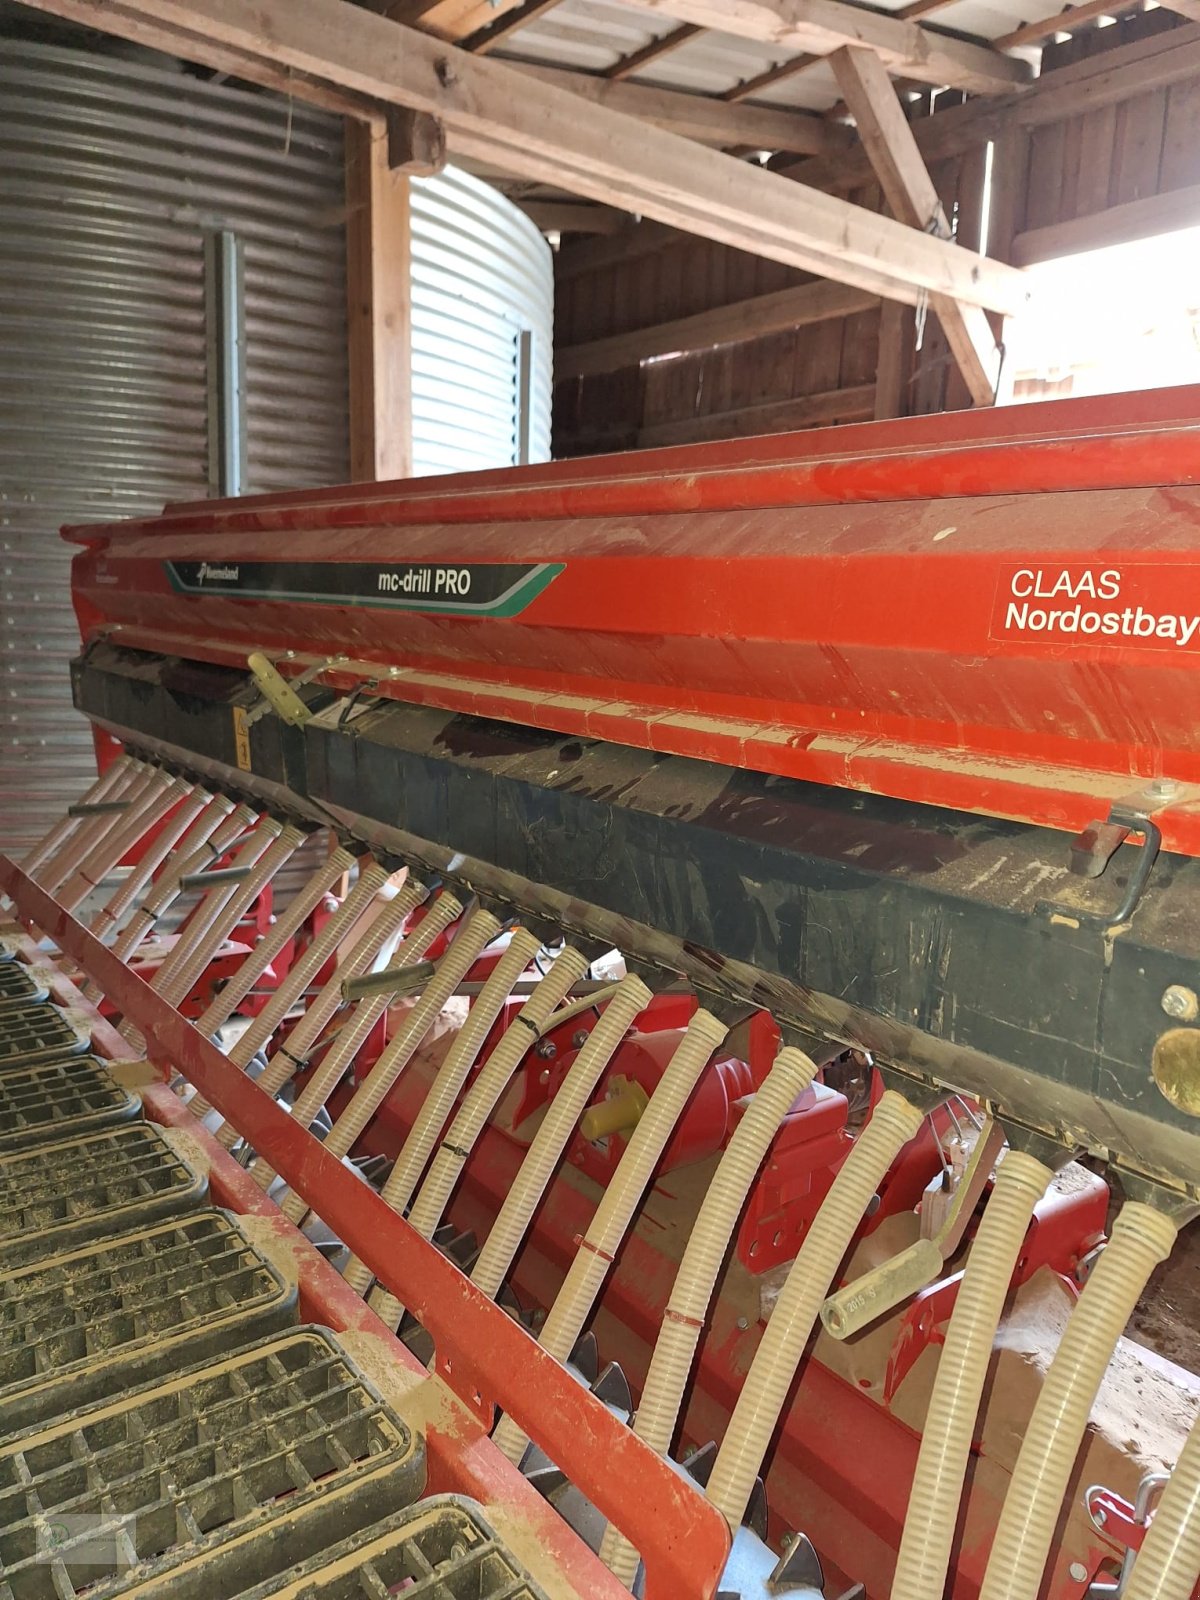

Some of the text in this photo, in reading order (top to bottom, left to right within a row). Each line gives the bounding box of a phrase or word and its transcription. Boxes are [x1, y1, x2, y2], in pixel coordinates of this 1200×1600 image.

[378, 569, 471, 595] mc-drill PRO
[1011, 569, 1121, 600] CLAAS
[1004, 602, 1200, 646] Nordostbay
